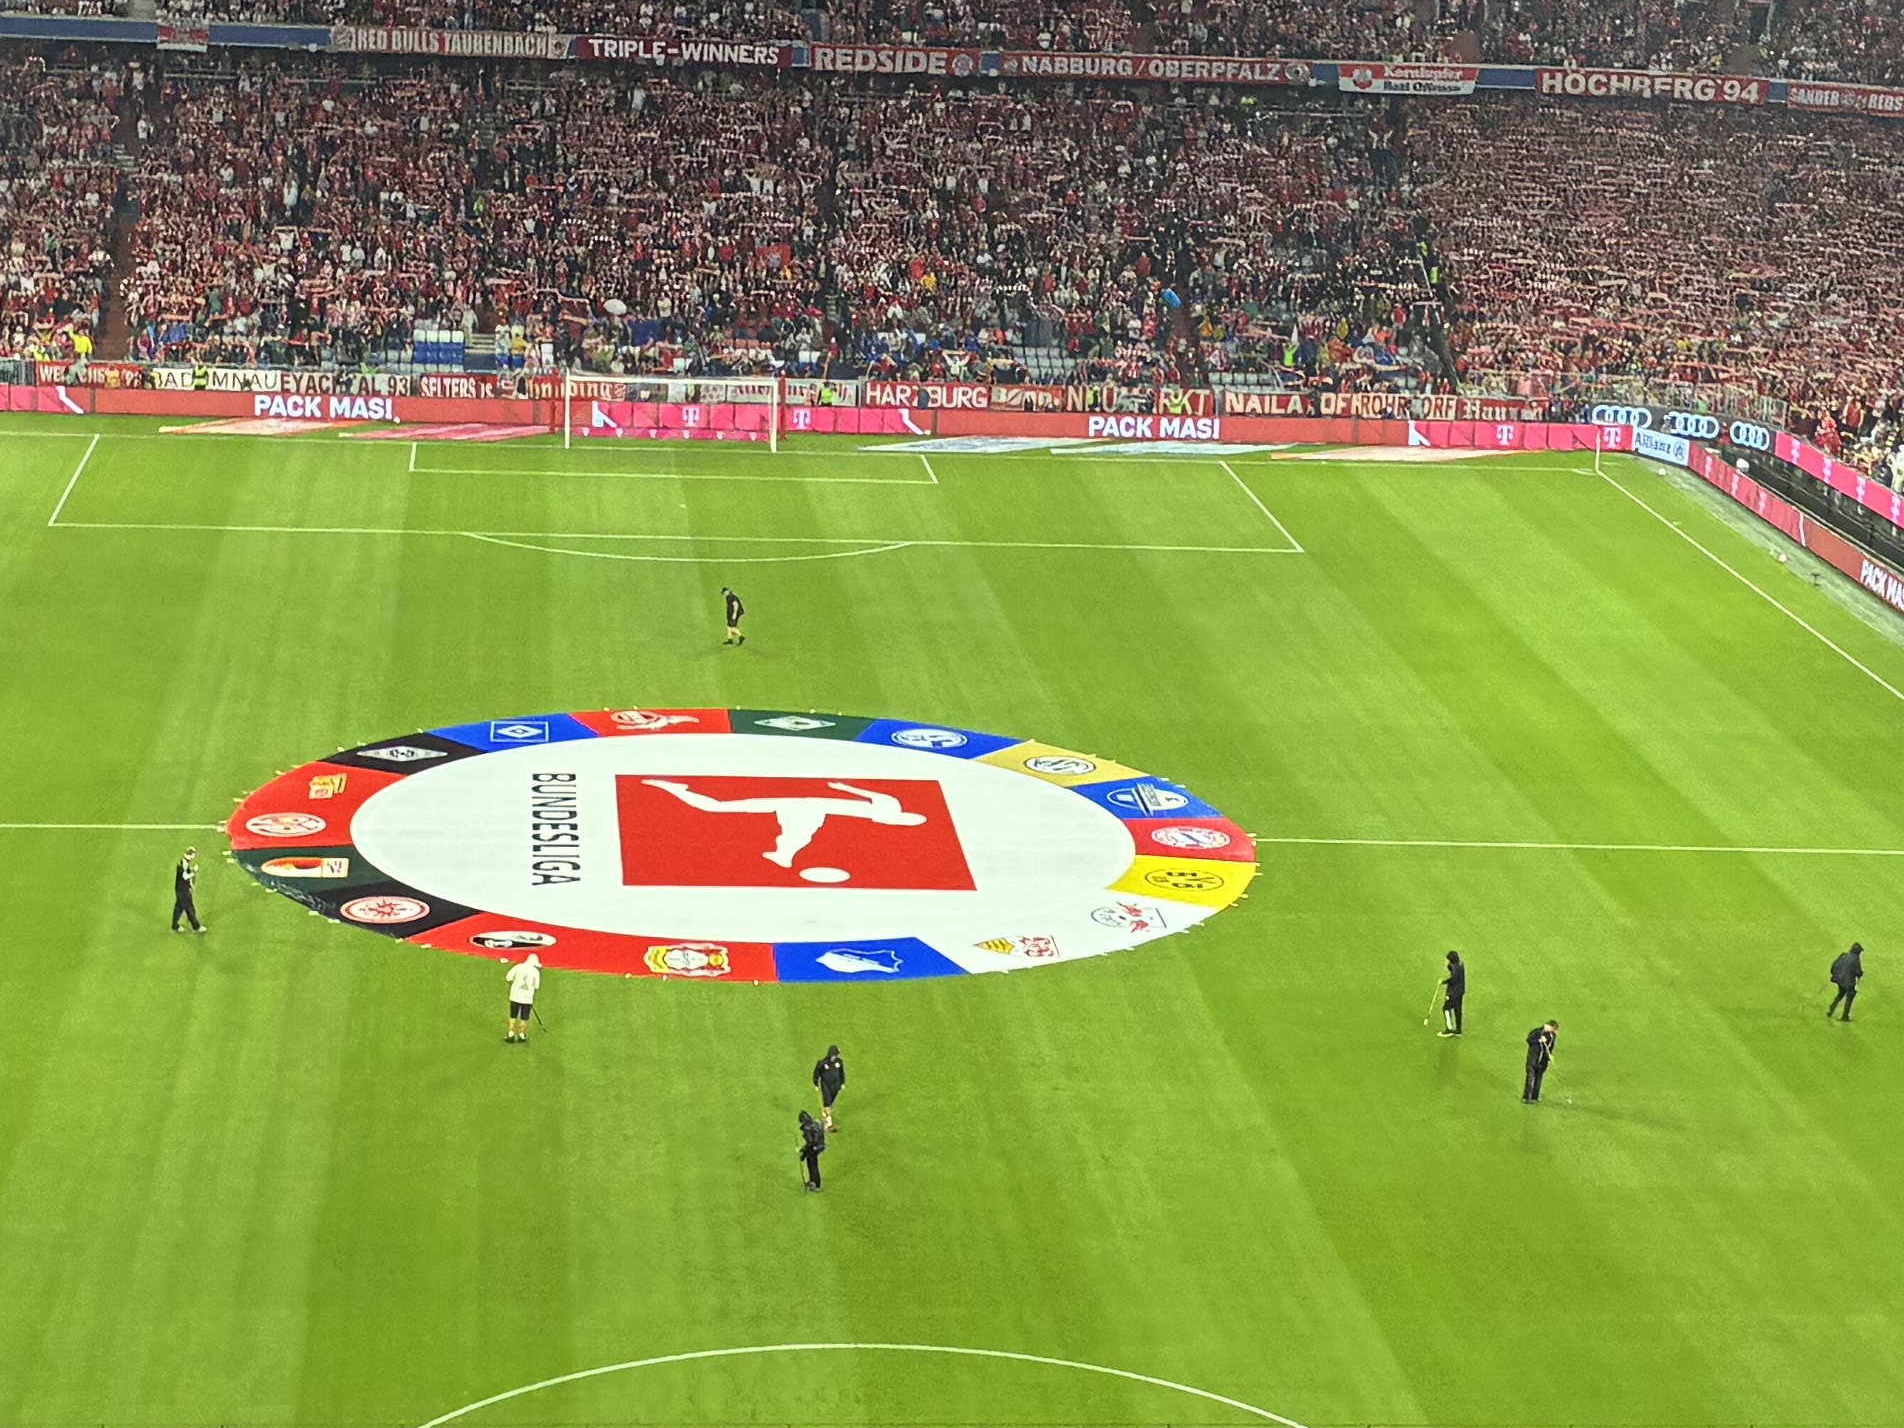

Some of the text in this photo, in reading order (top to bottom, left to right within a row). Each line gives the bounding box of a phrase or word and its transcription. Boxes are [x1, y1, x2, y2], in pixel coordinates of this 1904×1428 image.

[588, 39, 779, 65] TRIPLE-WINNERS
[815, 47, 947, 75] REDSIDE
[1022, 56, 1133, 76] NABBURG
[1148, 59, 1280, 81] OBERPFALZ
[255, 395, 325, 417] PACK
[1226, 392, 1303, 414] NAILA
[1089, 416, 1156, 438] PACK
[532, 772, 582, 887] BUNDESLIGA
